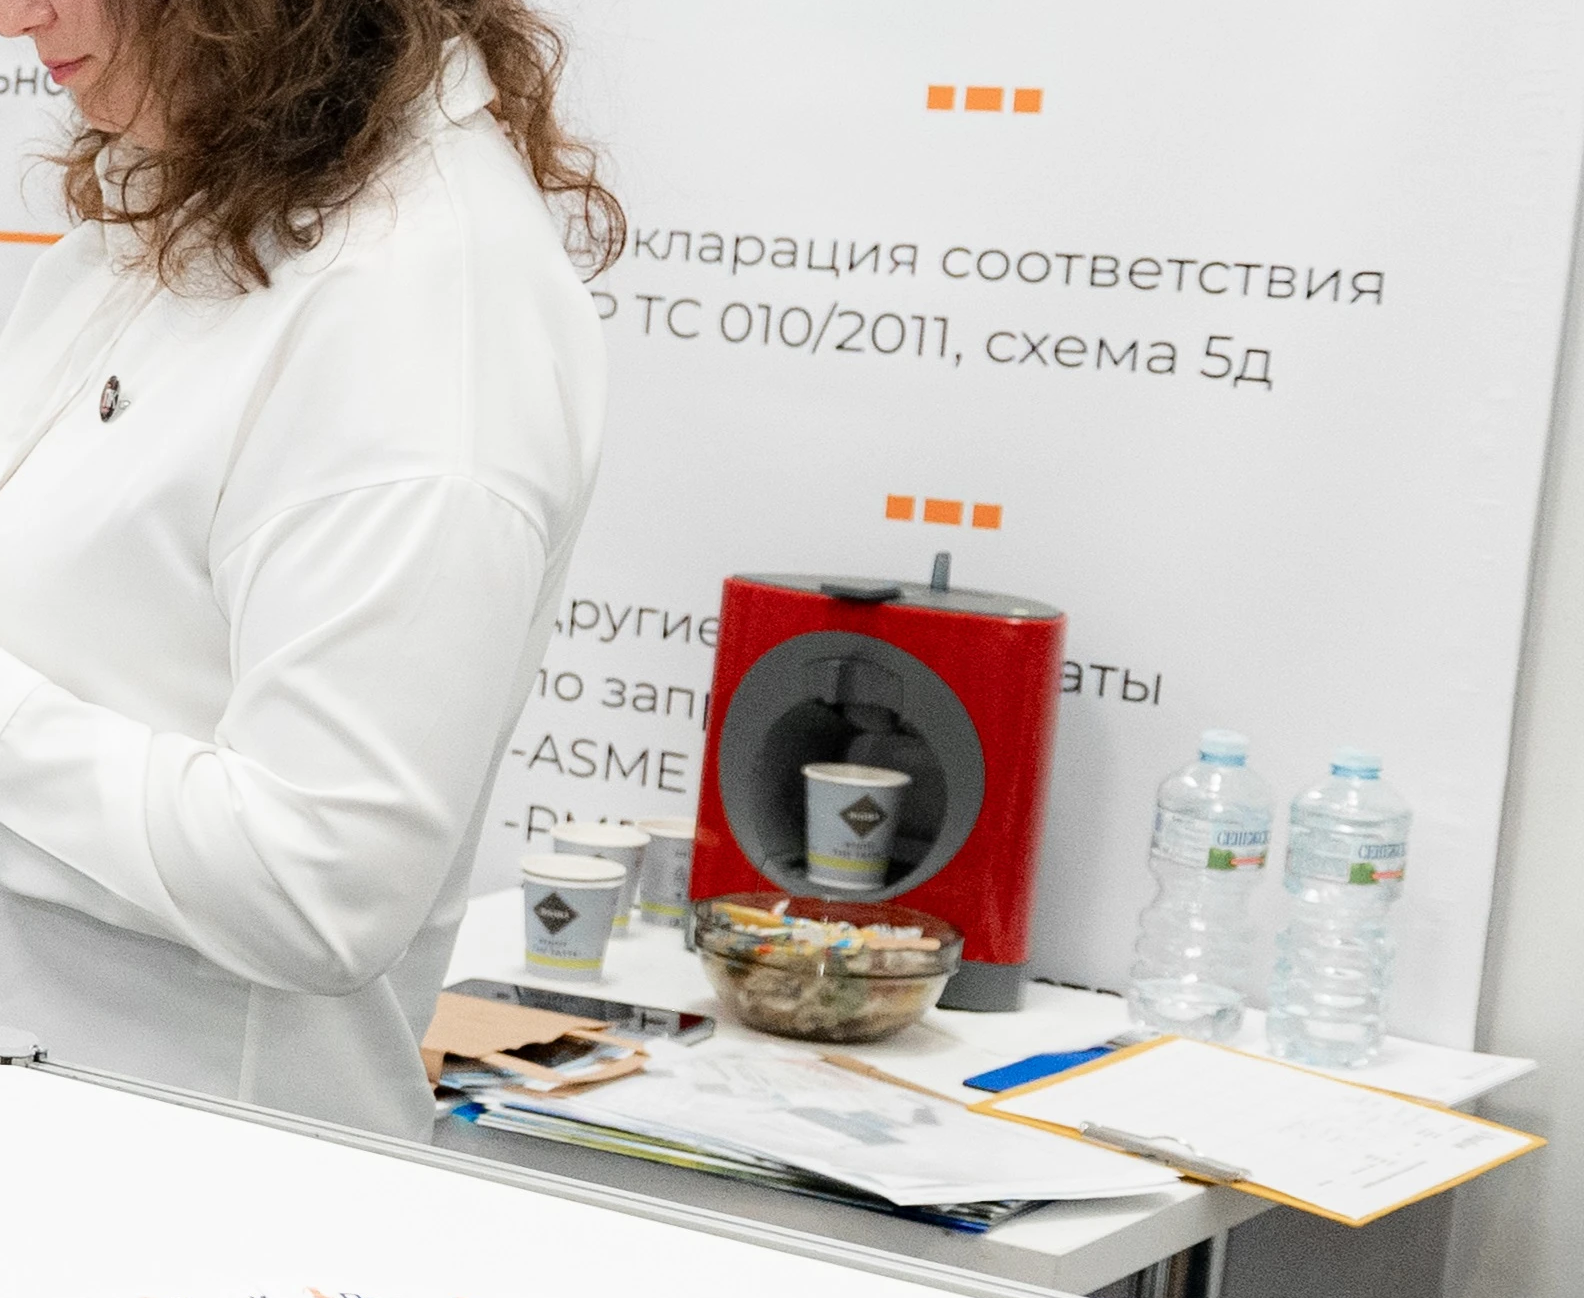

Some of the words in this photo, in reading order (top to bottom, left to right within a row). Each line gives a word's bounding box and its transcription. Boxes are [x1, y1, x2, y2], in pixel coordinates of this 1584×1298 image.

[941, 246, 1385, 305] соответствия
[635, 293, 702, 340] ТС
[719, 301, 963, 368] 010/2011,
[985, 330, 1178, 375] схема
[1199, 334, 1273, 391] 5д
[556, 599, 720, 648] ругие
